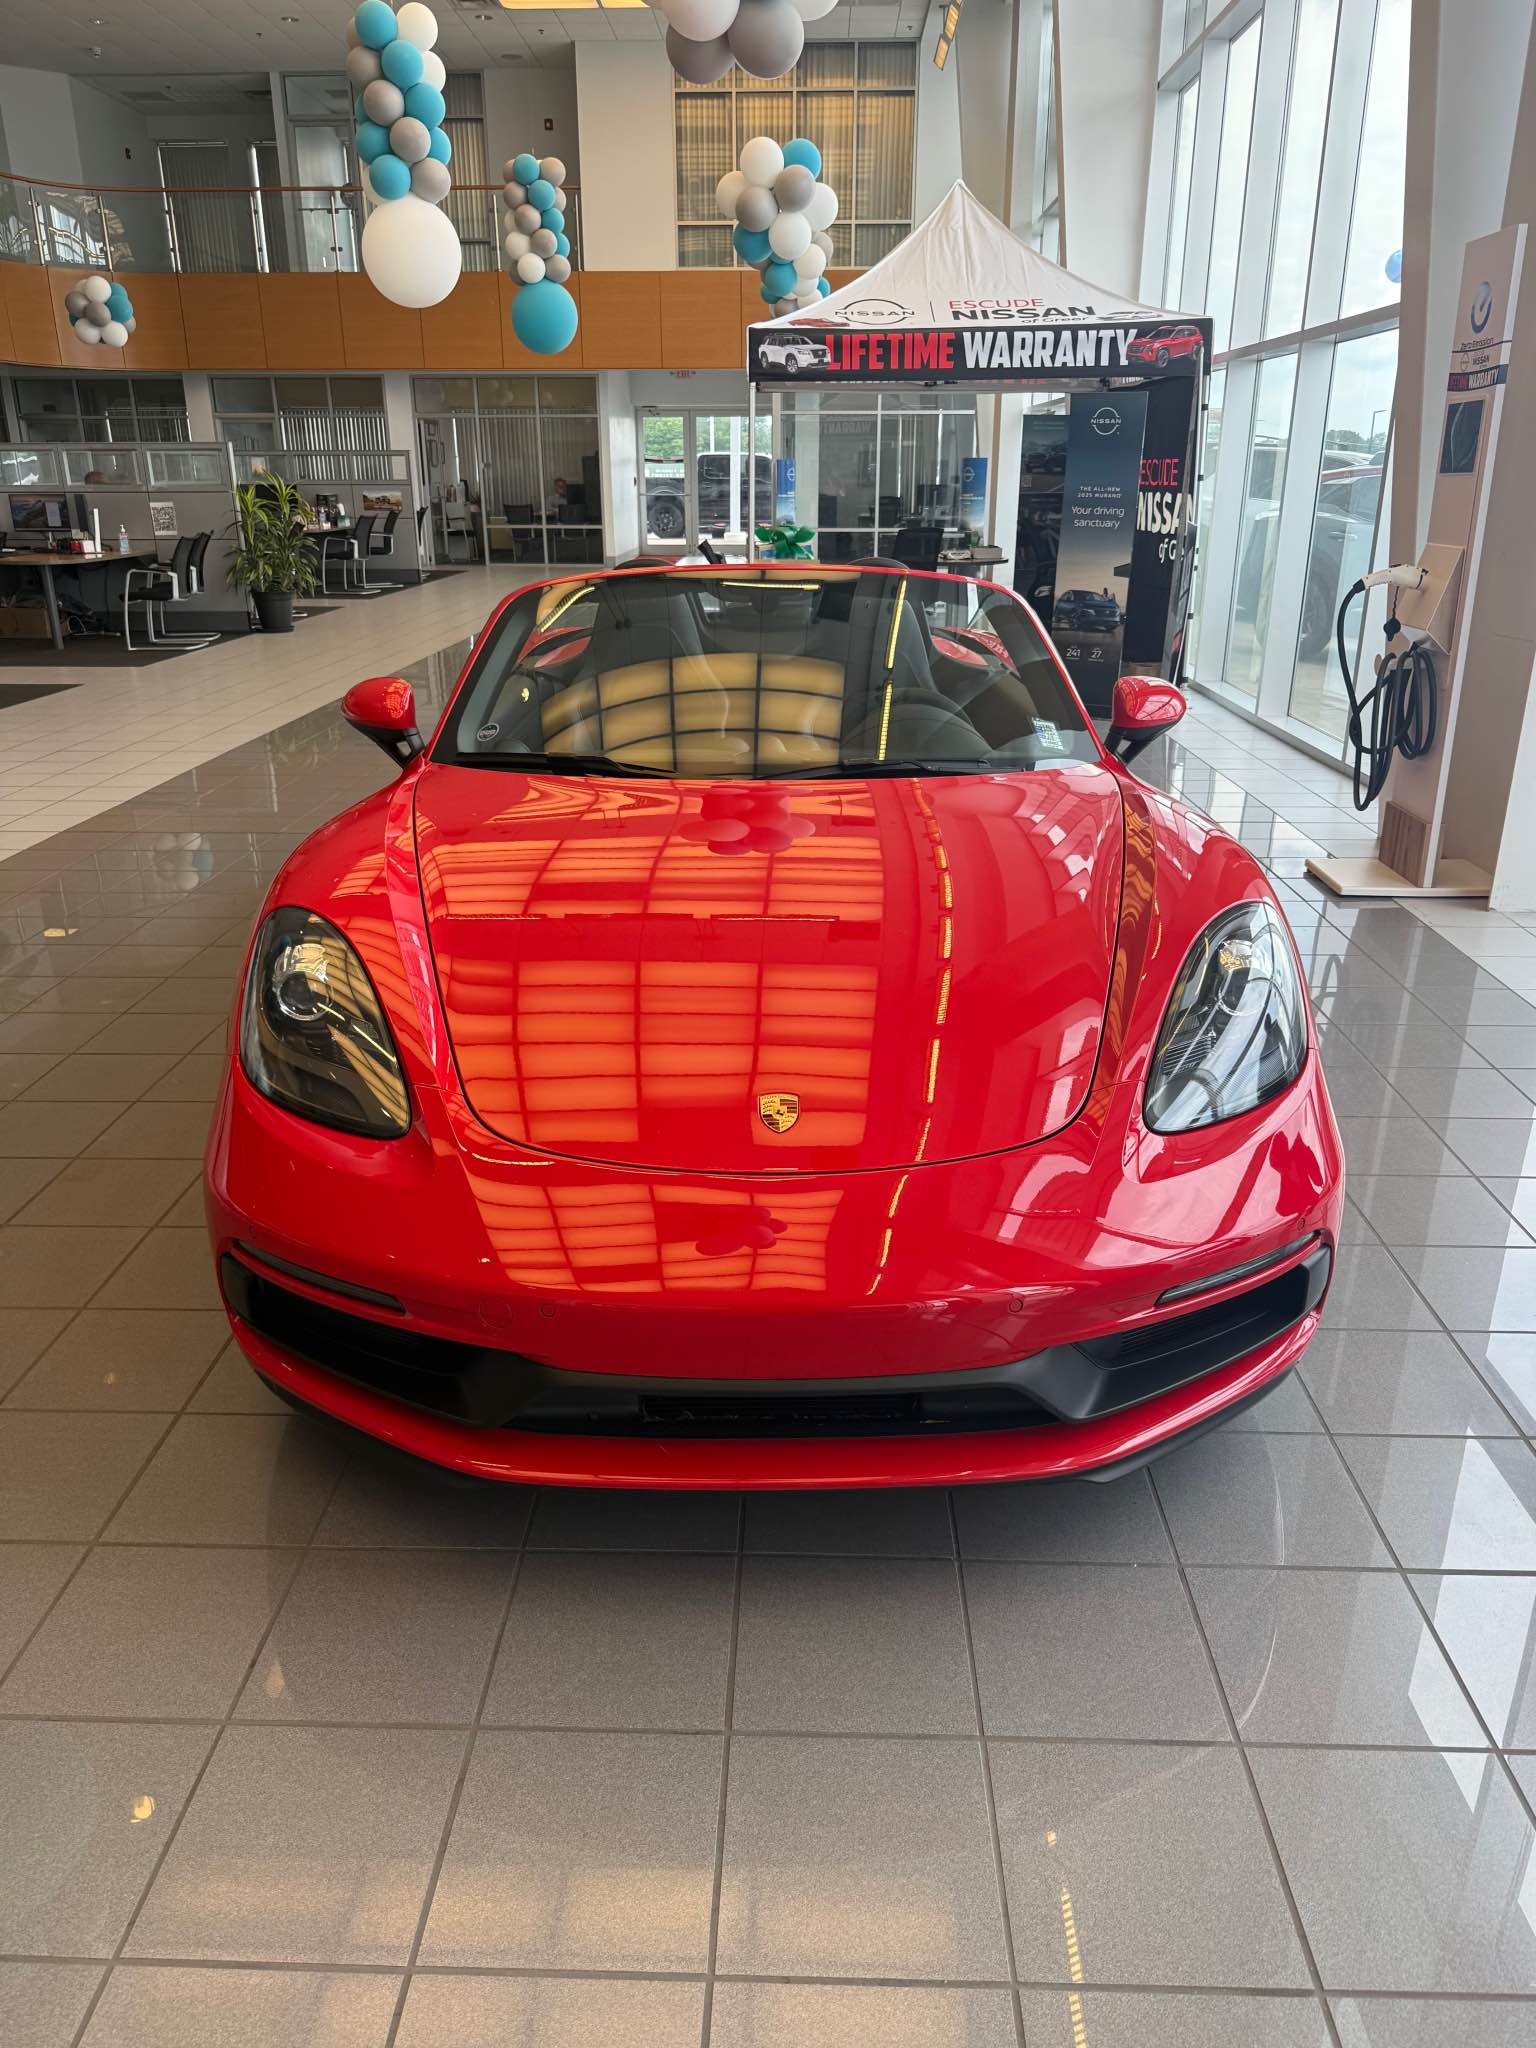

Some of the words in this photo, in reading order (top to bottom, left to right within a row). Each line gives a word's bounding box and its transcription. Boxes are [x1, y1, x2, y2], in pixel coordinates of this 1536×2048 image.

[949, 299, 1044, 309] ESCUDE
[952, 306, 1096, 320] NISSAN
[825, 332, 955, 370] LIFETIME
[962, 329, 1137, 369] WARRANTY
[1138, 459, 1180, 486] ESCUDE
[1071, 505, 1092, 515] Your
[1093, 506, 1125, 518] driving
[1073, 519, 1120, 529] sanctuary
